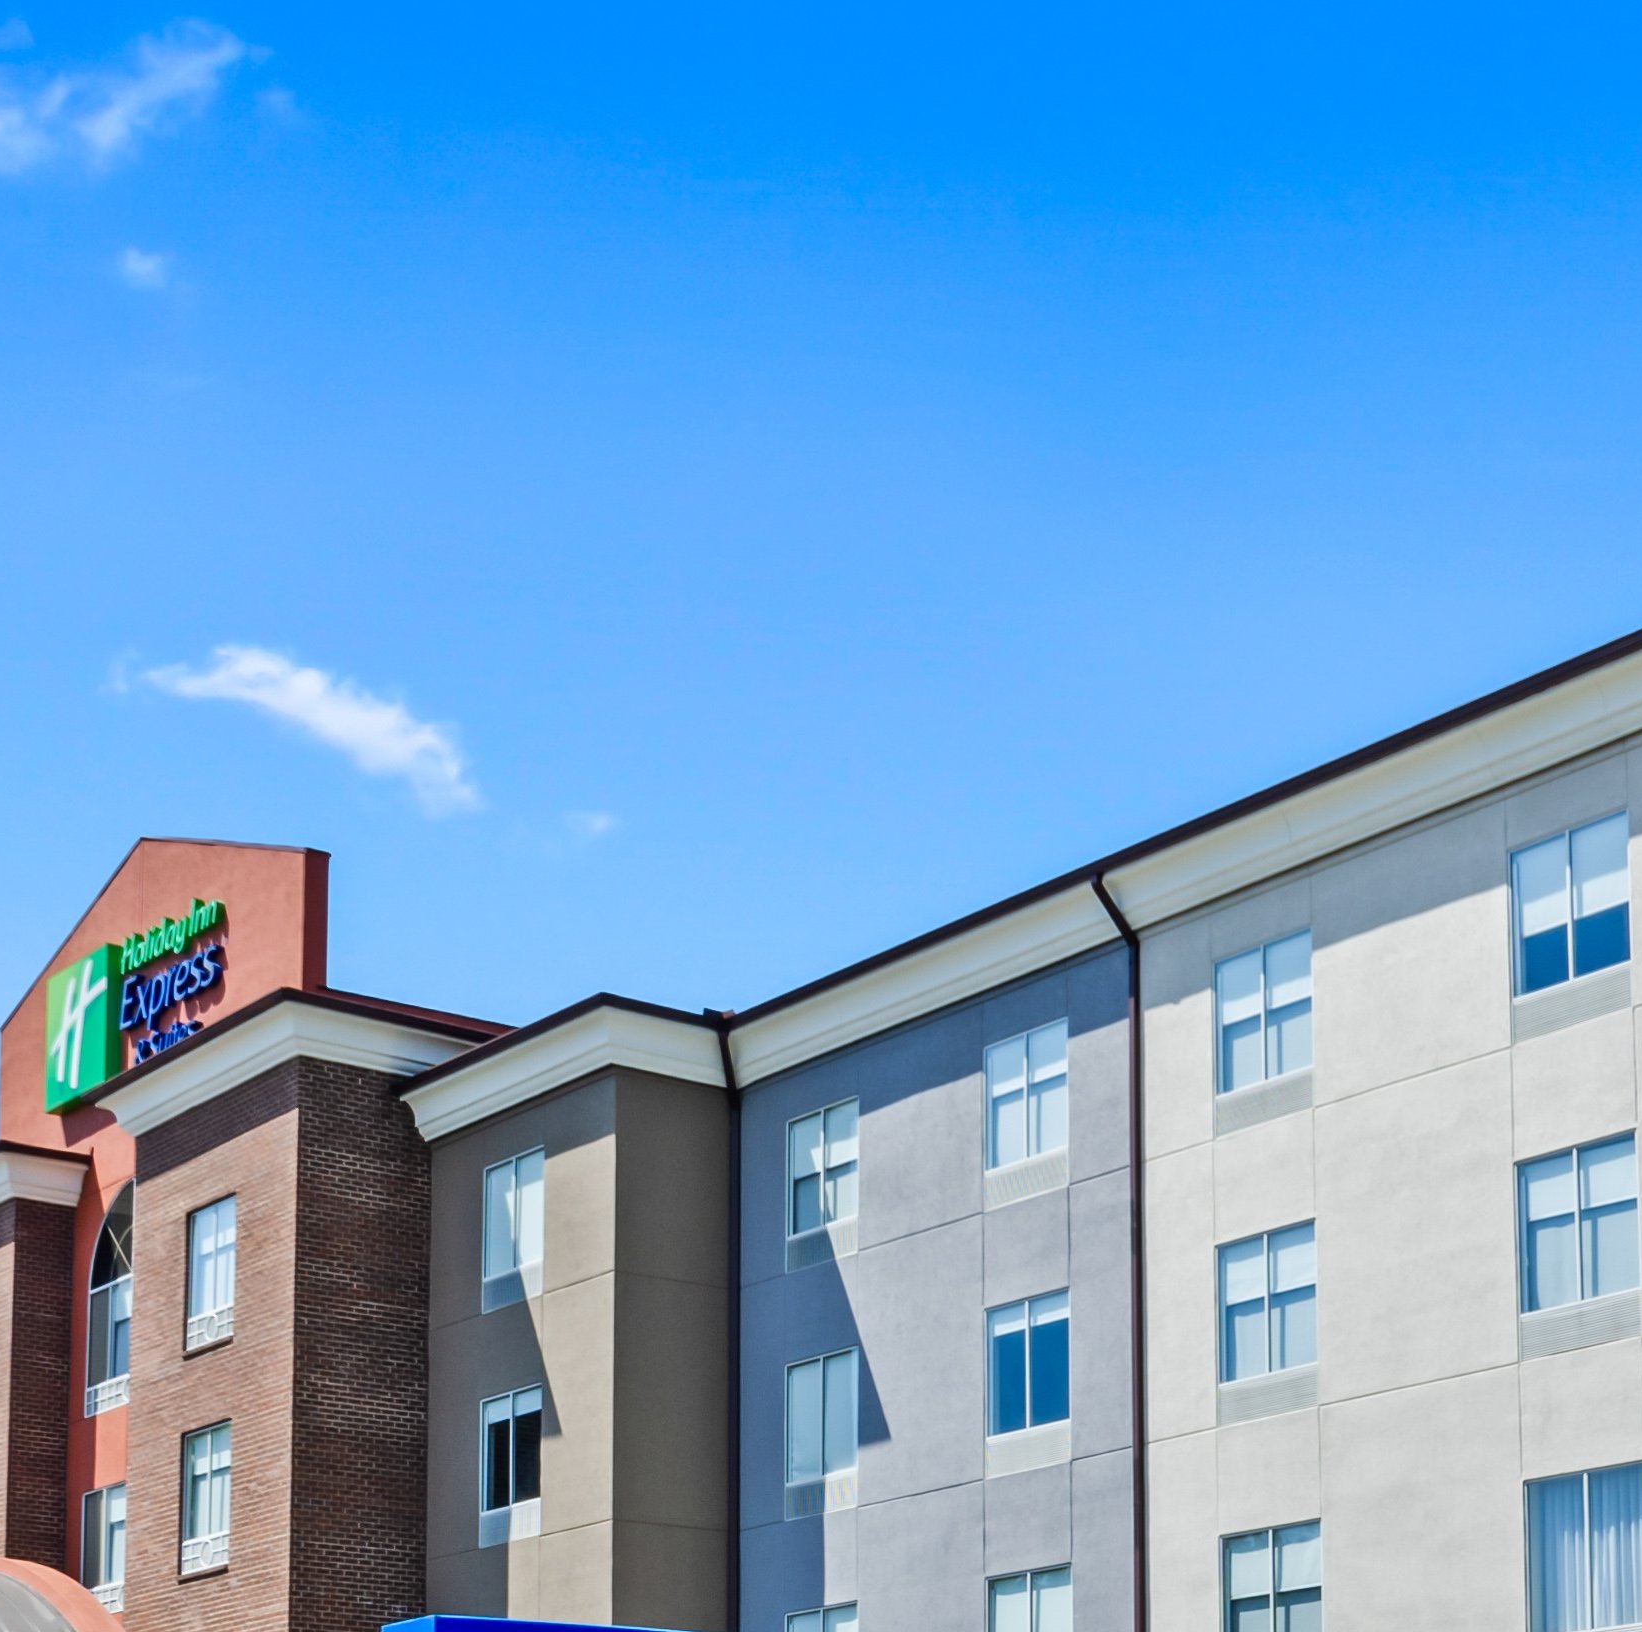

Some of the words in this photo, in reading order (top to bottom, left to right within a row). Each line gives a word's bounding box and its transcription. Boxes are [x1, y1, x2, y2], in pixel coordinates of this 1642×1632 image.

[120, 917, 187, 975] Holiday
[189, 898, 224, 937] Inn
[119, 944, 224, 1031] Express
